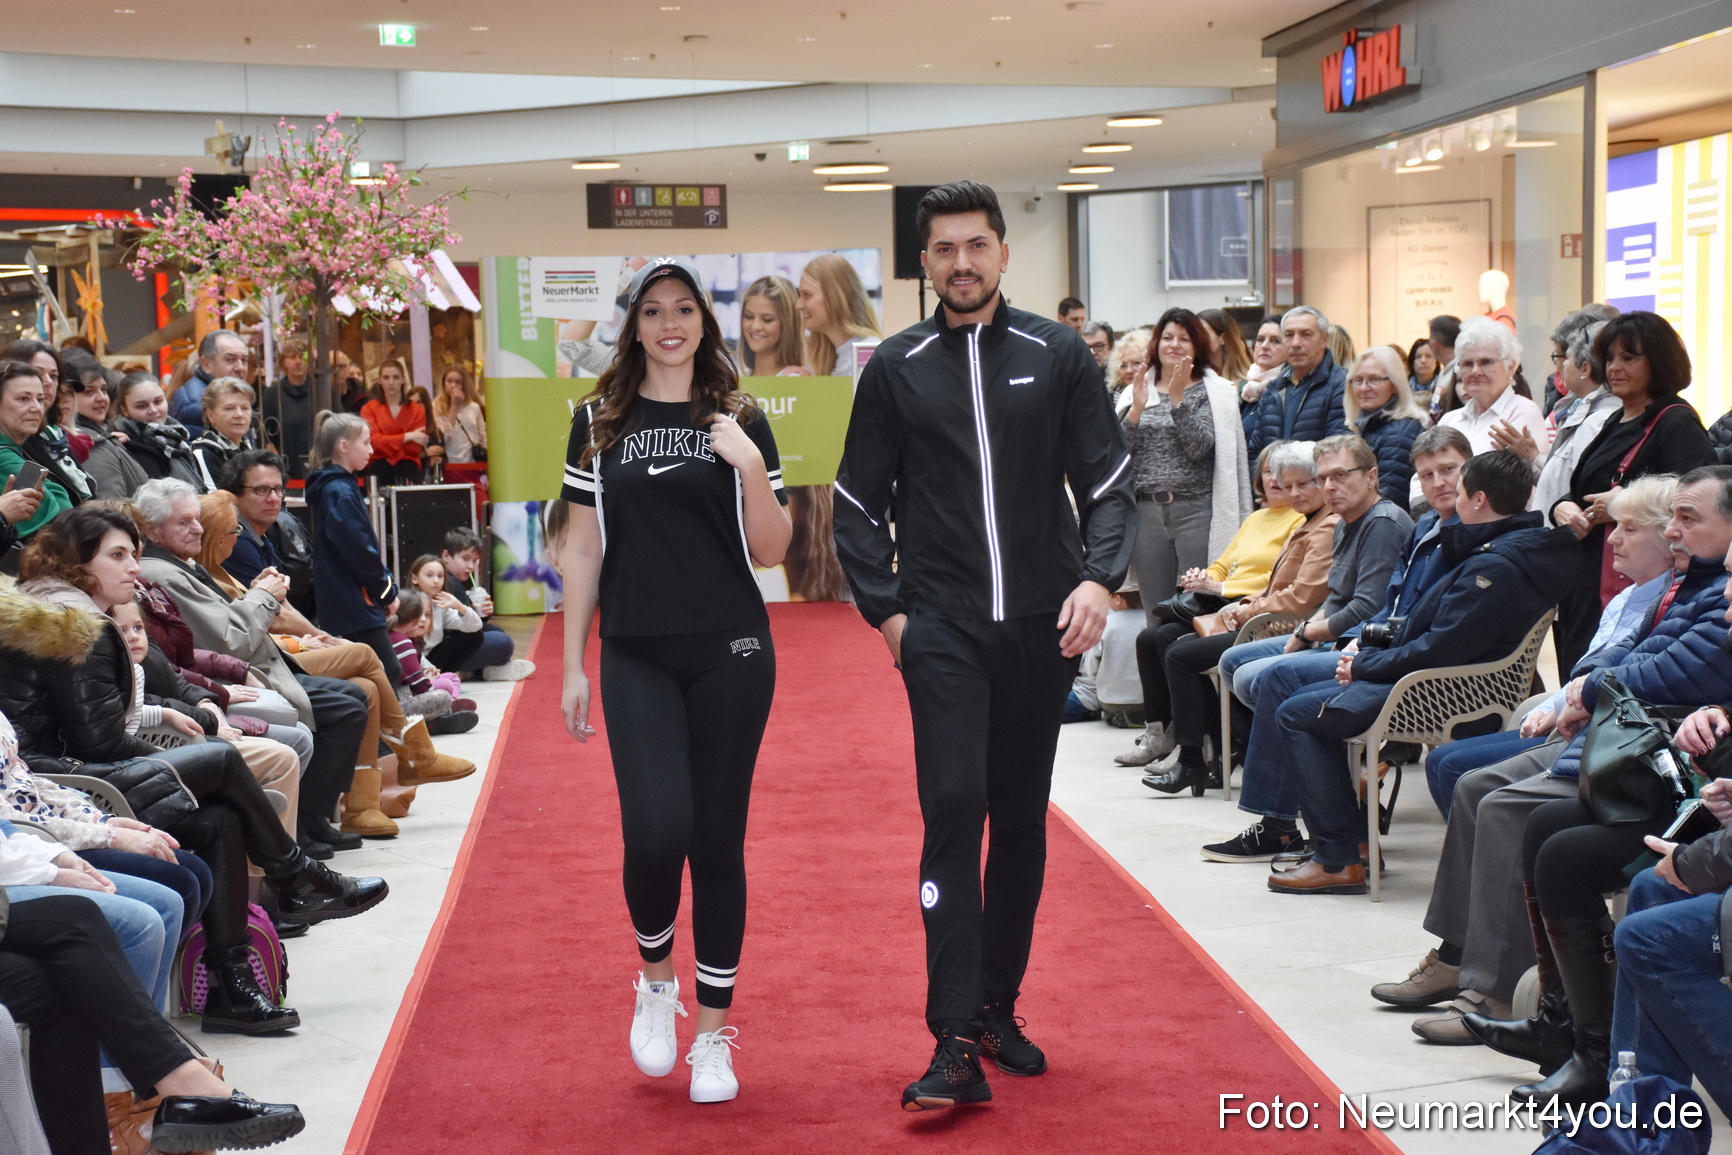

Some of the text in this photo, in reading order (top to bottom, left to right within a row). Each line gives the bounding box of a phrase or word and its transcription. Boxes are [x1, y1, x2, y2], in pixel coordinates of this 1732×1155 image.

[1321, 24, 1406, 113] WÖHRL
[615, 209, 673, 217] IN DER UNTEREN
[615, 219, 673, 227] LADENSTRASSE
[542, 286, 599, 296] NeuerMarkt
[1415, 298, 1444, 307] BRAX
[621, 428, 716, 464] NIKE
[730, 637, 761, 654] NIKE
